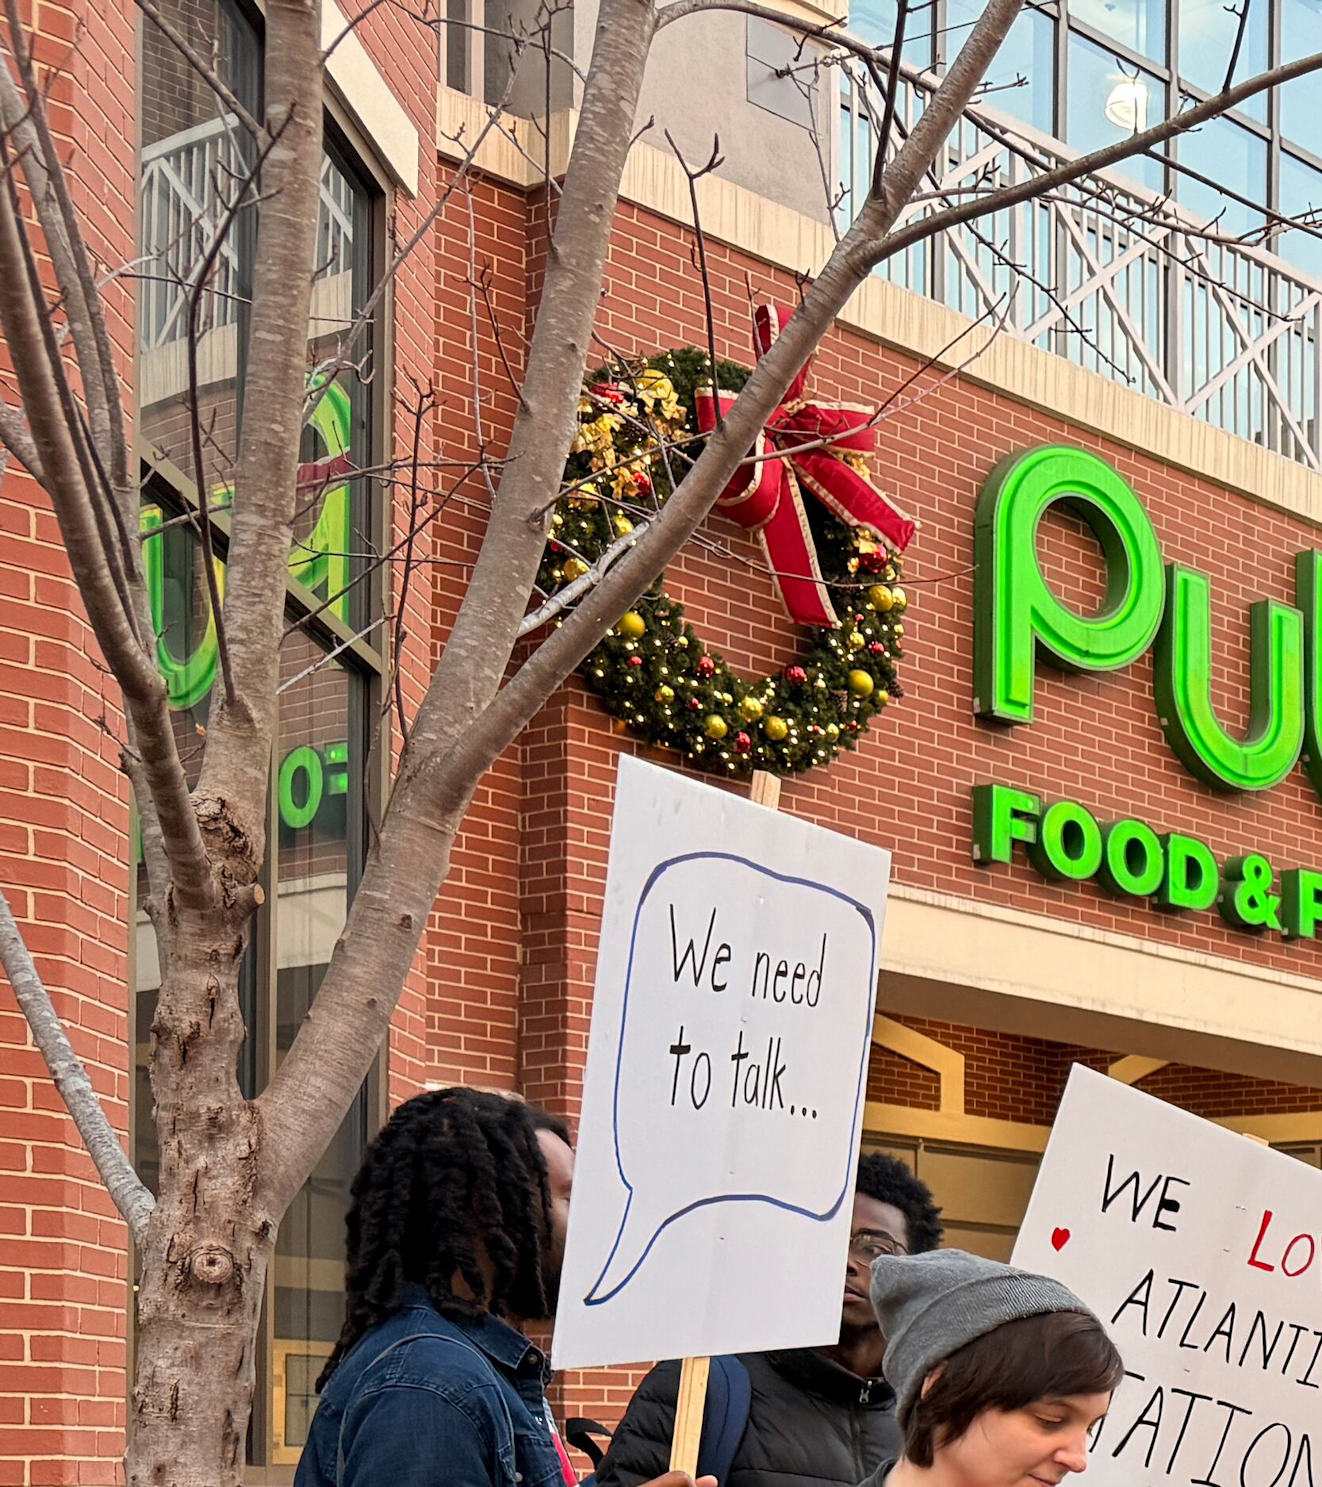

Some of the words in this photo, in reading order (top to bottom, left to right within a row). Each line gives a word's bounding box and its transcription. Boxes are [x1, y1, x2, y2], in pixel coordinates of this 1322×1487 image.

[974, 783, 1219, 910] FOOD
[1222, 853, 1283, 932] &
[670, 904, 731, 992] We
[751, 933, 826, 1008] need
[669, 1026, 711, 1110] to
[731, 1031, 818, 1119] talk...
[1101, 1153, 1190, 1232] WE
